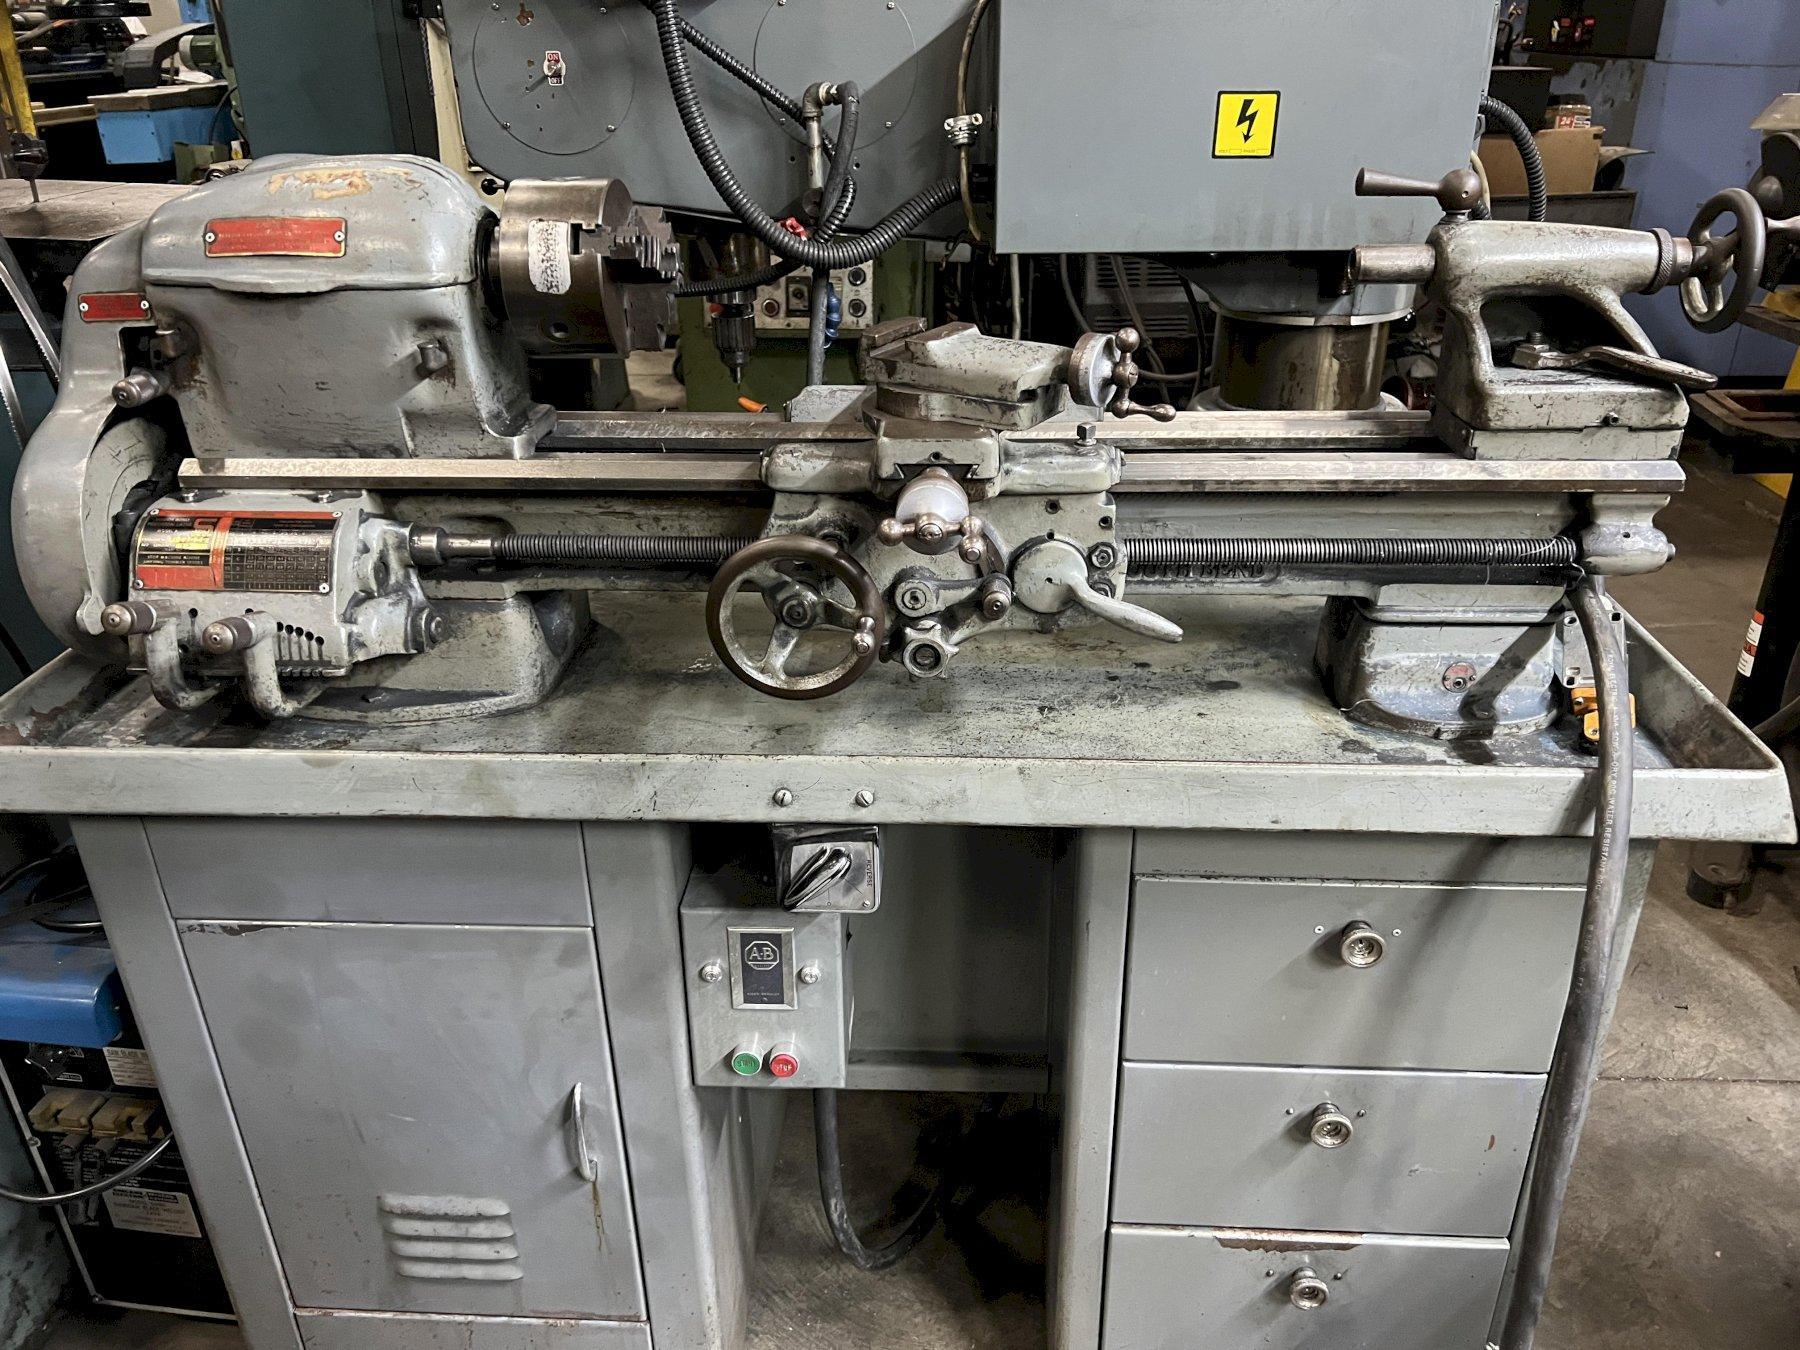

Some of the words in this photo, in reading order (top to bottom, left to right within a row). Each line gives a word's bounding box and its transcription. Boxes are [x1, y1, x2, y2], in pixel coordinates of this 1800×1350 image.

[547, 53, 559, 61] ON
[1605, 797, 1616, 825] WATER
[1599, 827, 1613, 873] RESISTANT
